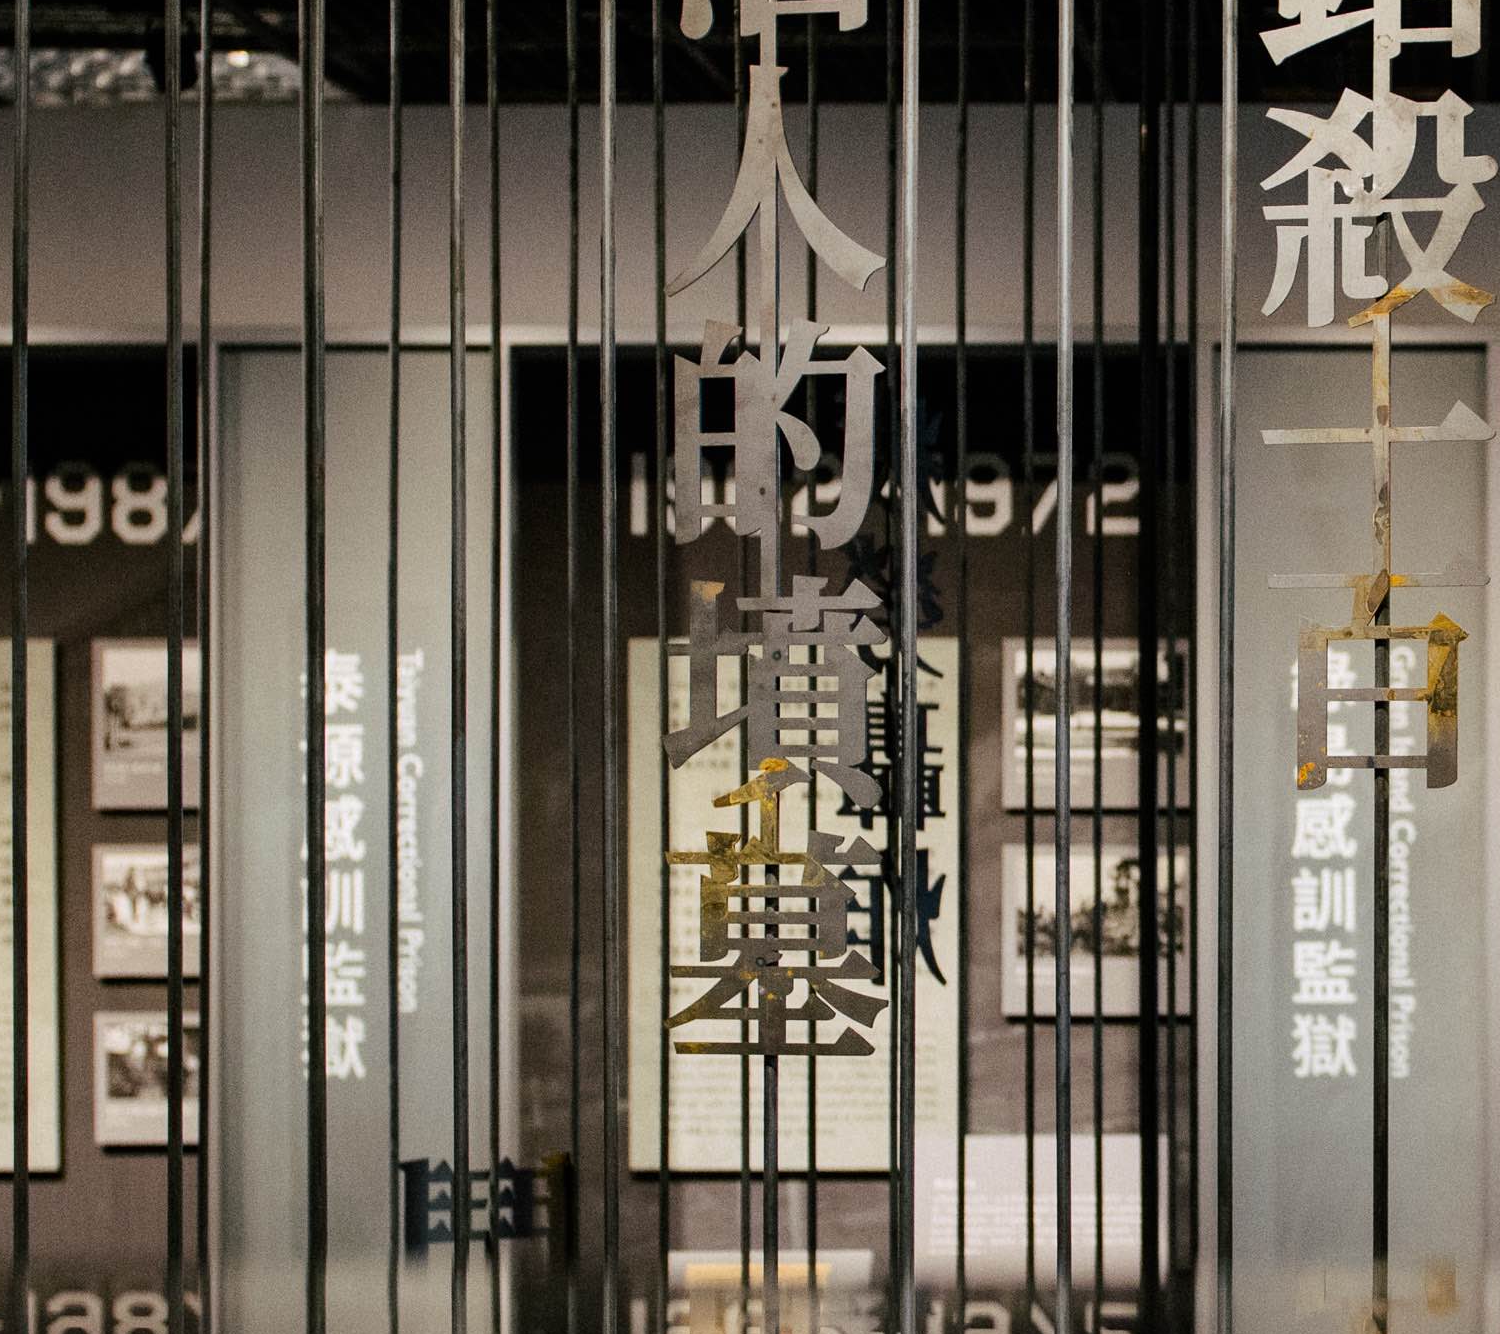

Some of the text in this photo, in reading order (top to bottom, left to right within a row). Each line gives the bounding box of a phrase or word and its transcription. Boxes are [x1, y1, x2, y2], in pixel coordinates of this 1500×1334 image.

[1389, 645, 1417, 1079] Gren Isand Correctional Prison
